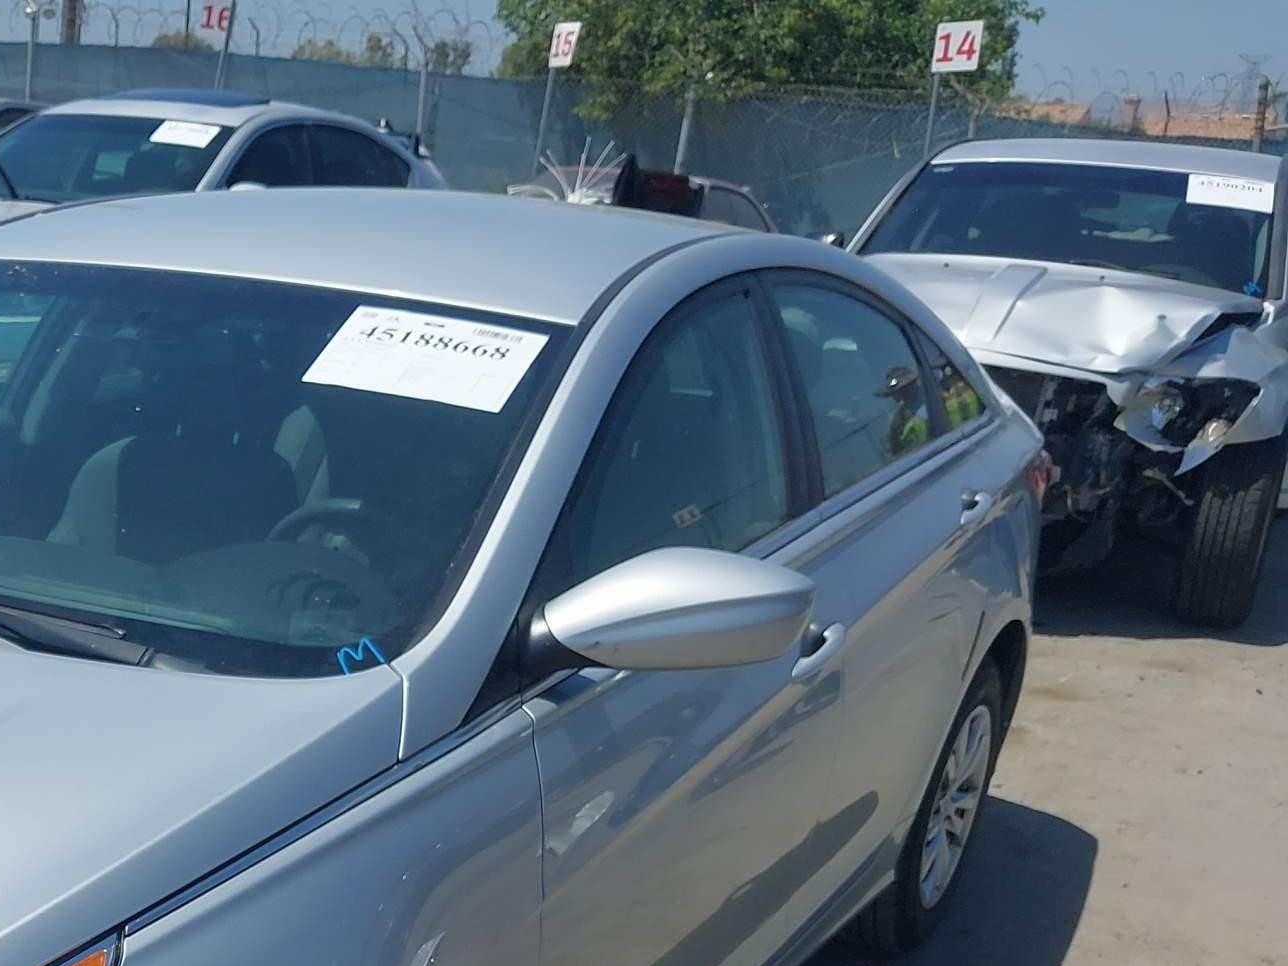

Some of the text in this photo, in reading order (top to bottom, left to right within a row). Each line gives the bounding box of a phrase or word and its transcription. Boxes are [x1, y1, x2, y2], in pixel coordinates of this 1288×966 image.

[200, 5, 232, 32] 16
[552, 31, 576, 58] 15
[936, 30, 977, 62] 14
[359, 325, 511, 361] 45188668
